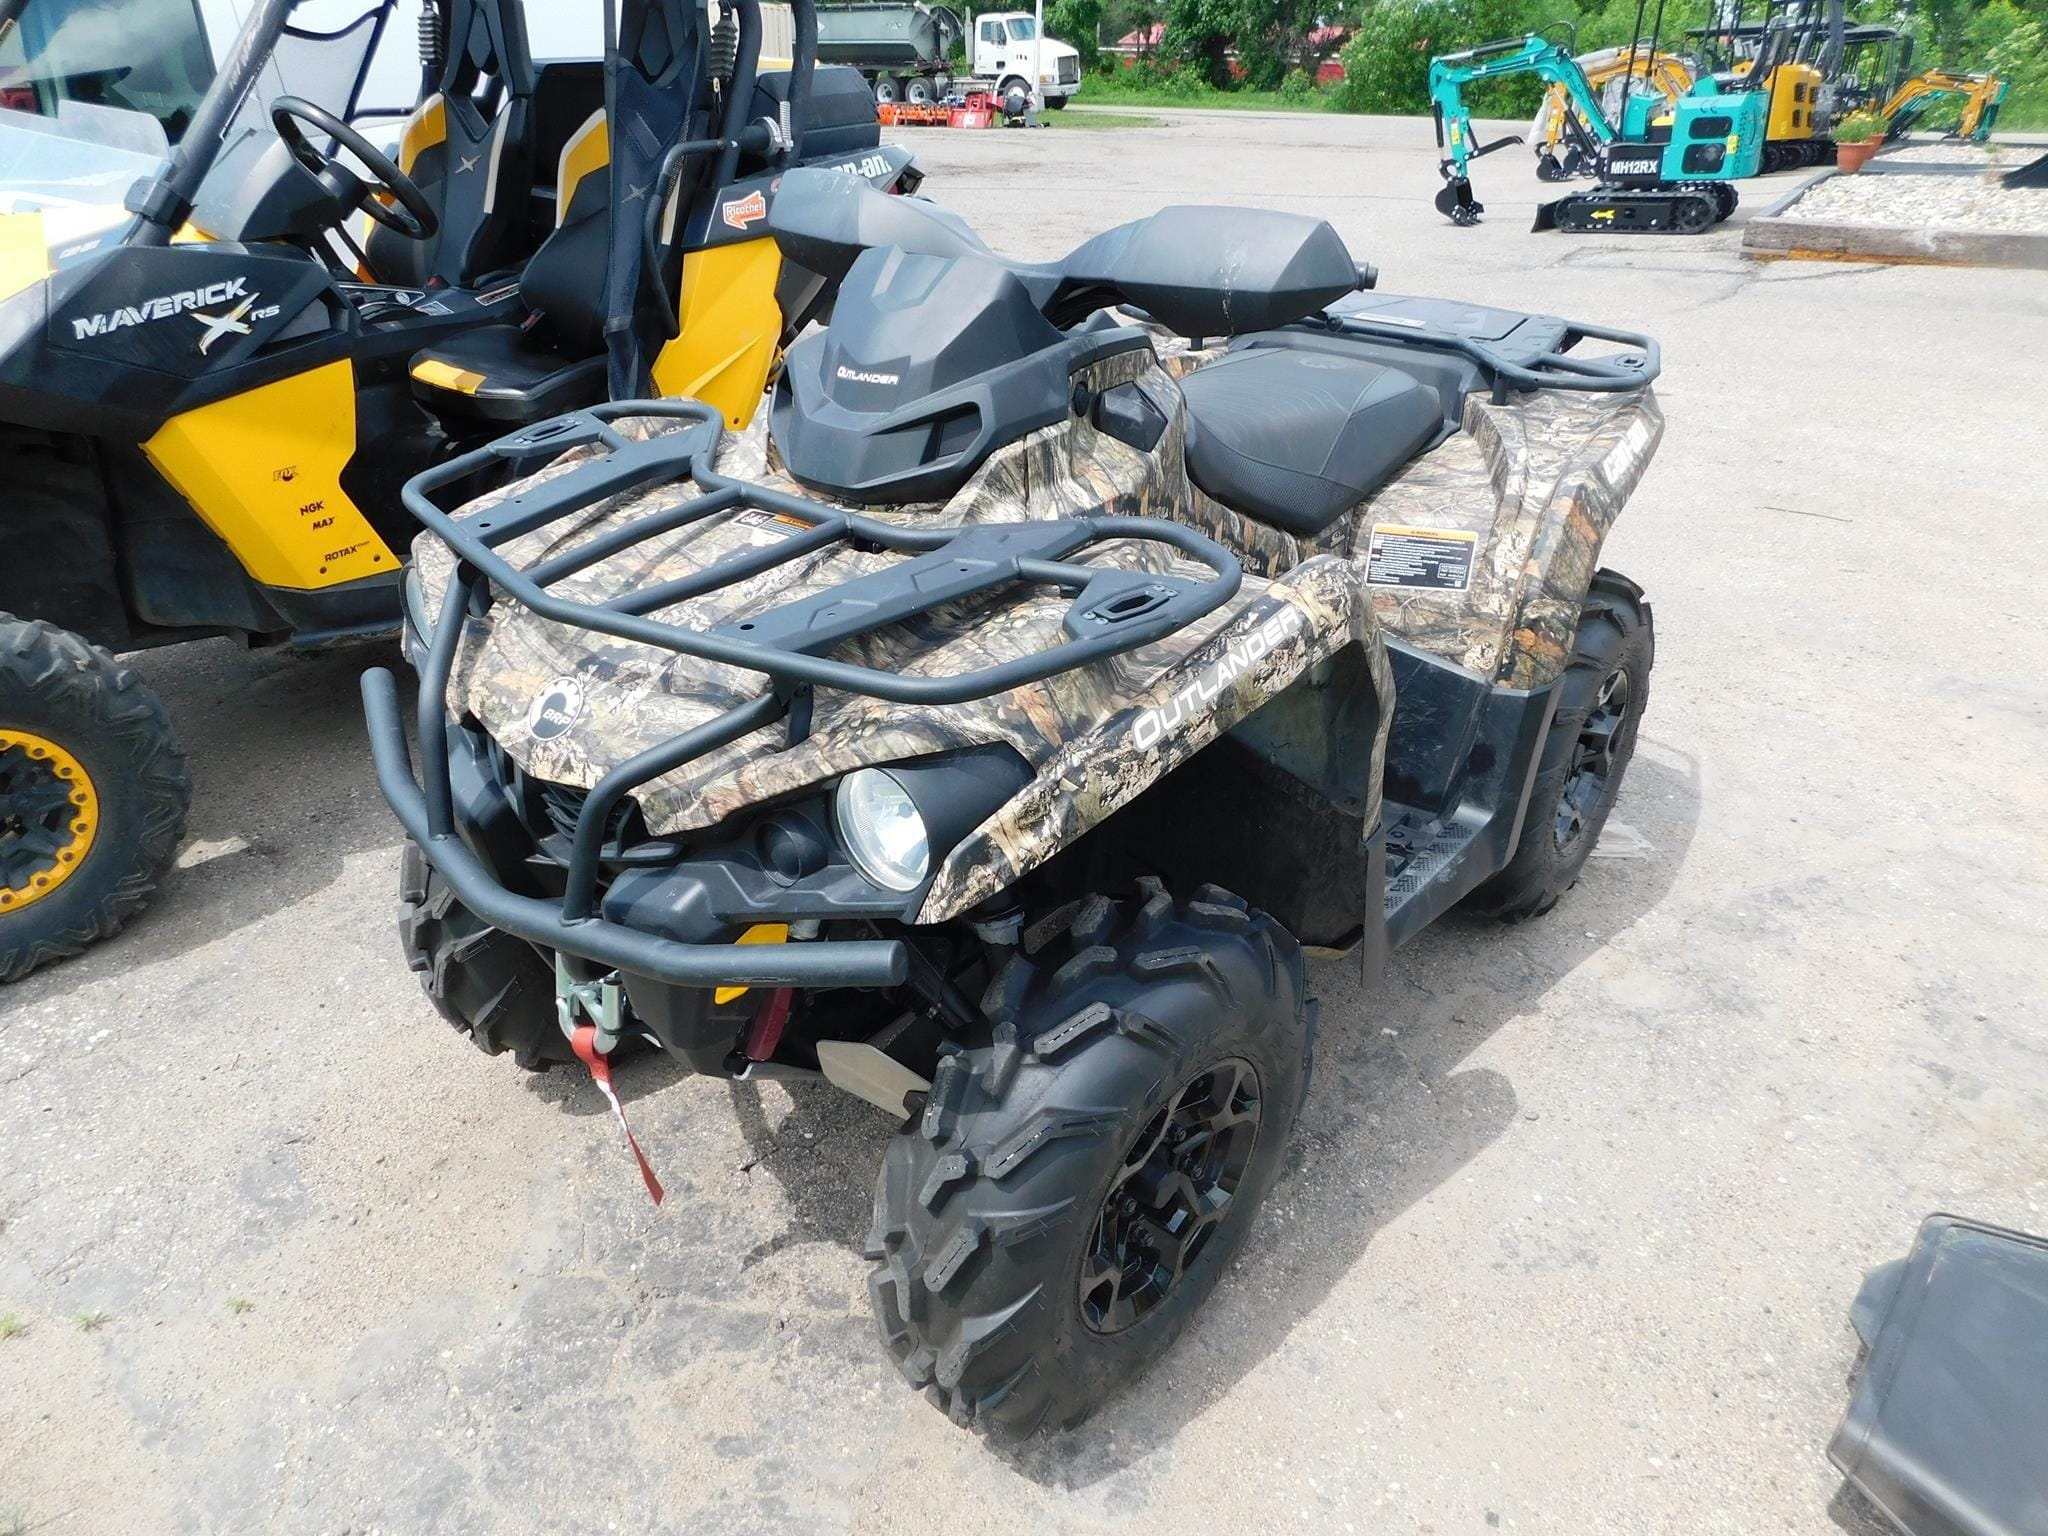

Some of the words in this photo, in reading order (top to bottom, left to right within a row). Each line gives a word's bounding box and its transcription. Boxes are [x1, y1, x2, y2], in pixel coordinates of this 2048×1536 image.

[1610, 160, 1658, 174] MH12RX
[726, 201, 763, 217] Ricochet
[72, 276, 248, 341] MAVERICK
[837, 365, 899, 385] OUTLANDER
[273, 465, 299, 481] FOX
[300, 500, 325, 516] NGK
[324, 545, 358, 562] ROTAX
[1133, 603, 1303, 752] OUTLANDER
[542, 708, 573, 726] BRP
